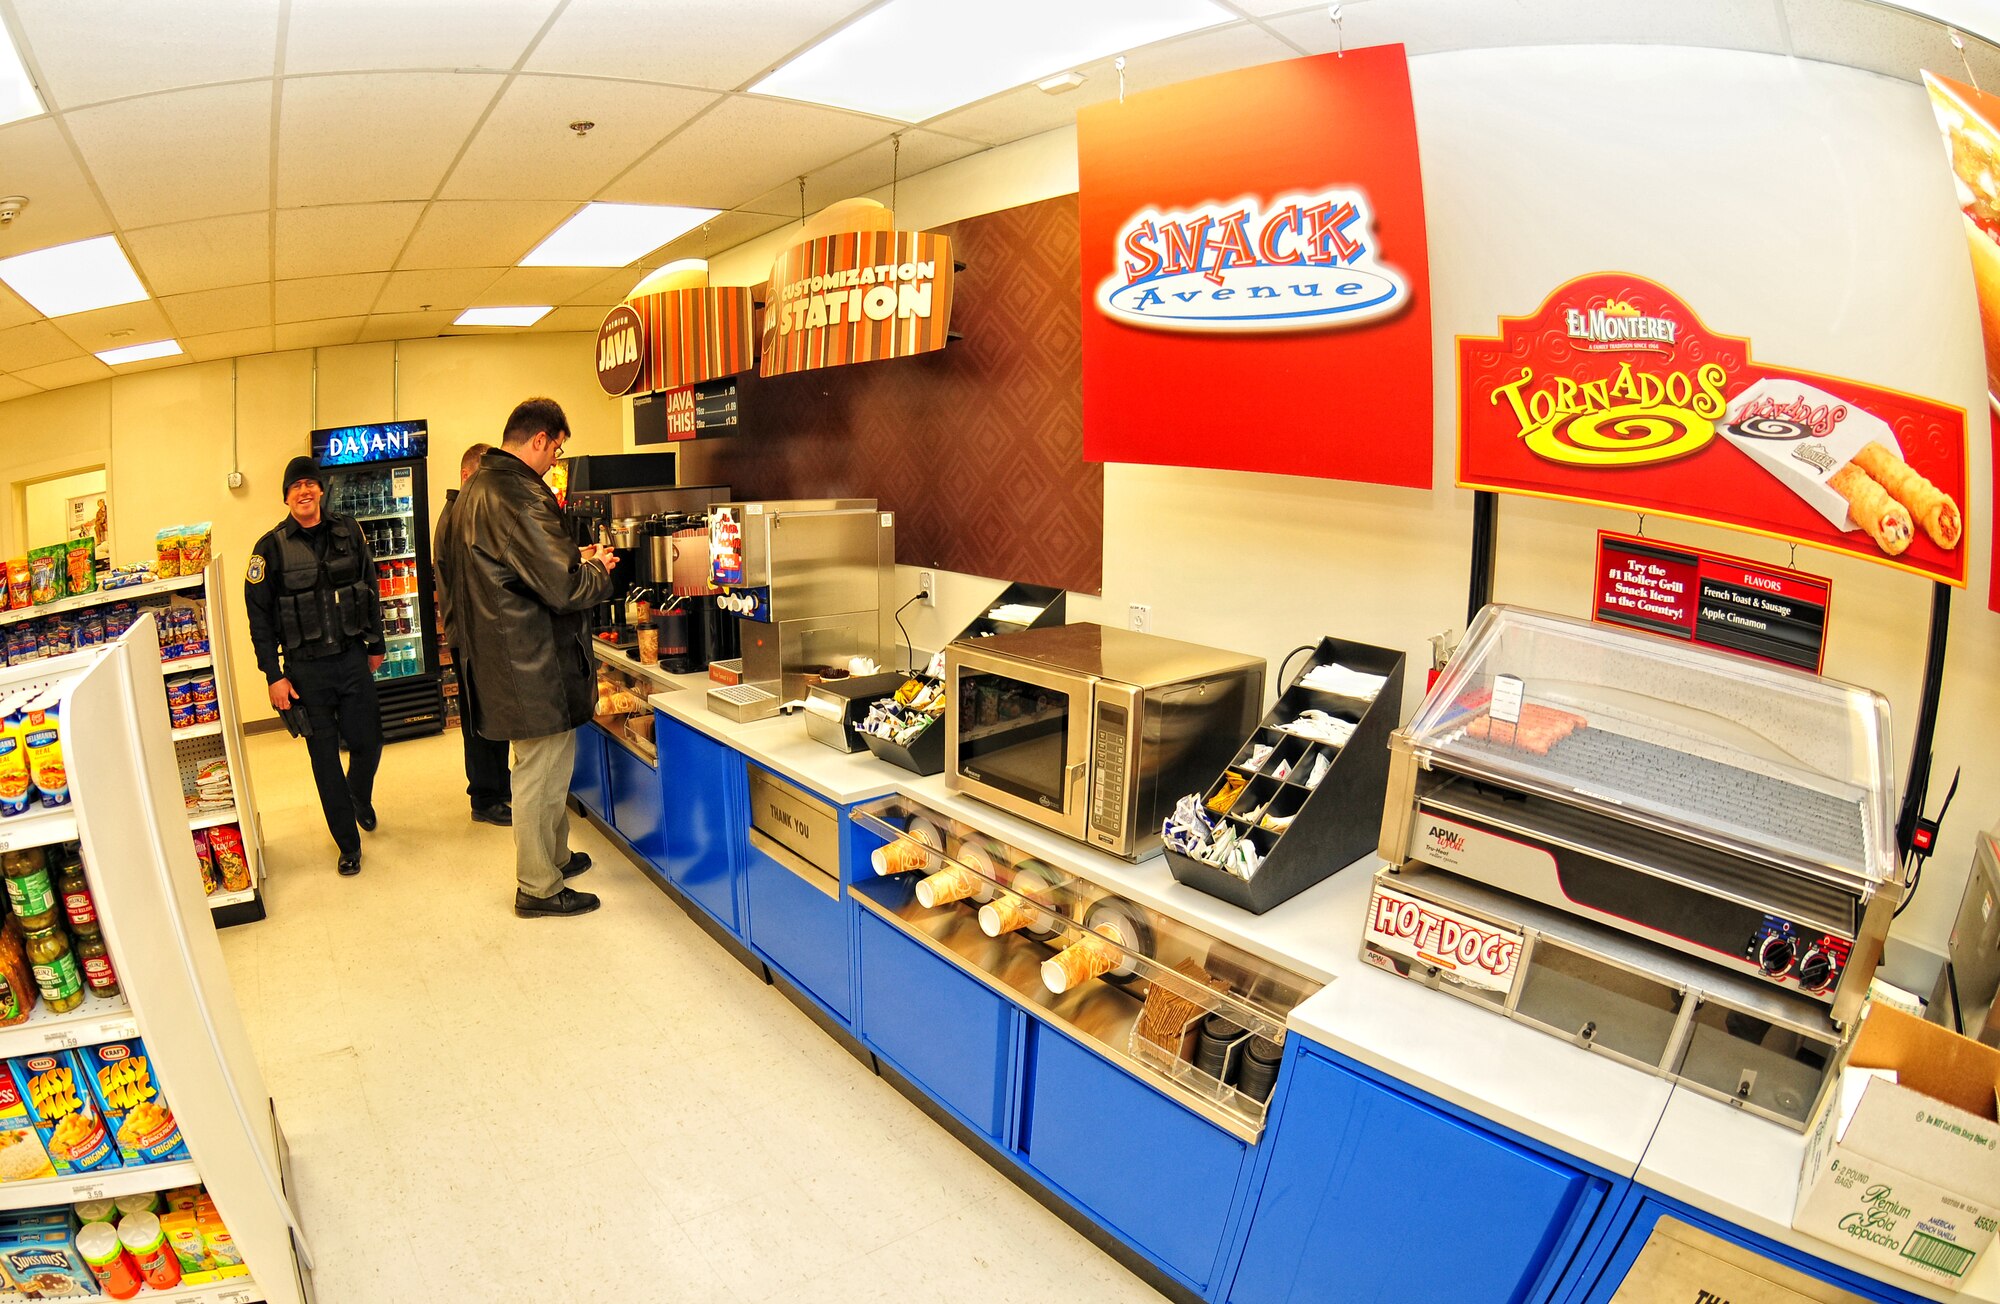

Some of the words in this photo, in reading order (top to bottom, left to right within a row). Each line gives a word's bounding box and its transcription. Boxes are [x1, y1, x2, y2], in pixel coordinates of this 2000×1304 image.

[1124, 200, 1367, 287] SNACK
[782, 261, 935, 301] CUSTOMIZATION
[1132, 282, 1364, 311] Avenue
[780, 282, 933, 336] STATION
[605, 316, 628, 333] PREMIUM
[1589, 307, 1676, 344] MONTEREY
[599, 326, 638, 373] JAVA
[667, 390, 694, 413] JAVA
[1491, 361, 1727, 438] TORNADOS
[667, 411, 695, 433] THIS!
[1727, 395, 1848, 438] TORNADOS
[329, 429, 409, 458] DASANI
[1628, 559, 1646, 575] Try
[1649, 564, 1666, 576] the
[1609, 569, 1622, 580] #1
[1623, 572, 1657, 588] Roller
[1658, 578, 1683, 593] Grill
[1744, 574, 1781, 592] FLAVORS
[1615, 583, 1648, 599] Snack
[1650, 590, 1674, 603] Item
[1703, 586, 1731, 600] French
[1732, 592, 1751, 606] Toast
[1752, 598, 1760, 608] &
[1761, 600, 1792, 617] Sausage
[1605, 592, 1616, 604] in
[1618, 594, 1635, 608] the
[1637, 600, 1683, 620] Country!
[1702, 607, 1725, 623] Apple
[1726, 612, 1767, 630] Cinnamon
[35, 747, 51, 756] REAL
[770, 804, 792, 830] THANK
[794, 818, 809, 839] YOU
[1429, 826, 1458, 843] APW
[1374, 896, 1439, 949] HOT
[1437, 918, 1515, 976] DOGS
[34, 969, 51, 977] HEINZ
[61, 1038, 78, 1048] 1.59
[118, 1028, 136, 1038] 1.79
[33, 1059, 51, 1068] KRAFT
[105, 1048, 124, 1057] KRAFT
[27, 1067, 73, 1110] EASY
[97, 1055, 148, 1099] EASY
[36, 1083, 83, 1120] MAC
[106, 1071, 157, 1109] MAC
[71, 1147, 79, 1158] 6
[142, 1136, 149, 1147] 6
[151, 1131, 182, 1156] ORIGINAL
[81, 1142, 110, 1167] ORIGINAL
[1834, 1176, 1855, 1190] BAGS
[1846, 1169, 1869, 1185] POUND
[87, 1190, 104, 1199] 3.59
[1861, 1184, 1911, 1219] Premium
[1860, 1207, 1896, 1232] Gold
[1928, 1217, 1956, 1231] AMERICAN
[1974, 1215, 1998, 1233] 45630
[1838, 1212, 1900, 1251] Cappuccino
[1915, 1221, 1936, 1234] FRENCH
[1936, 1229, 1957, 1242] VANILLA
[11, 1256, 41, 1271] SWISS
